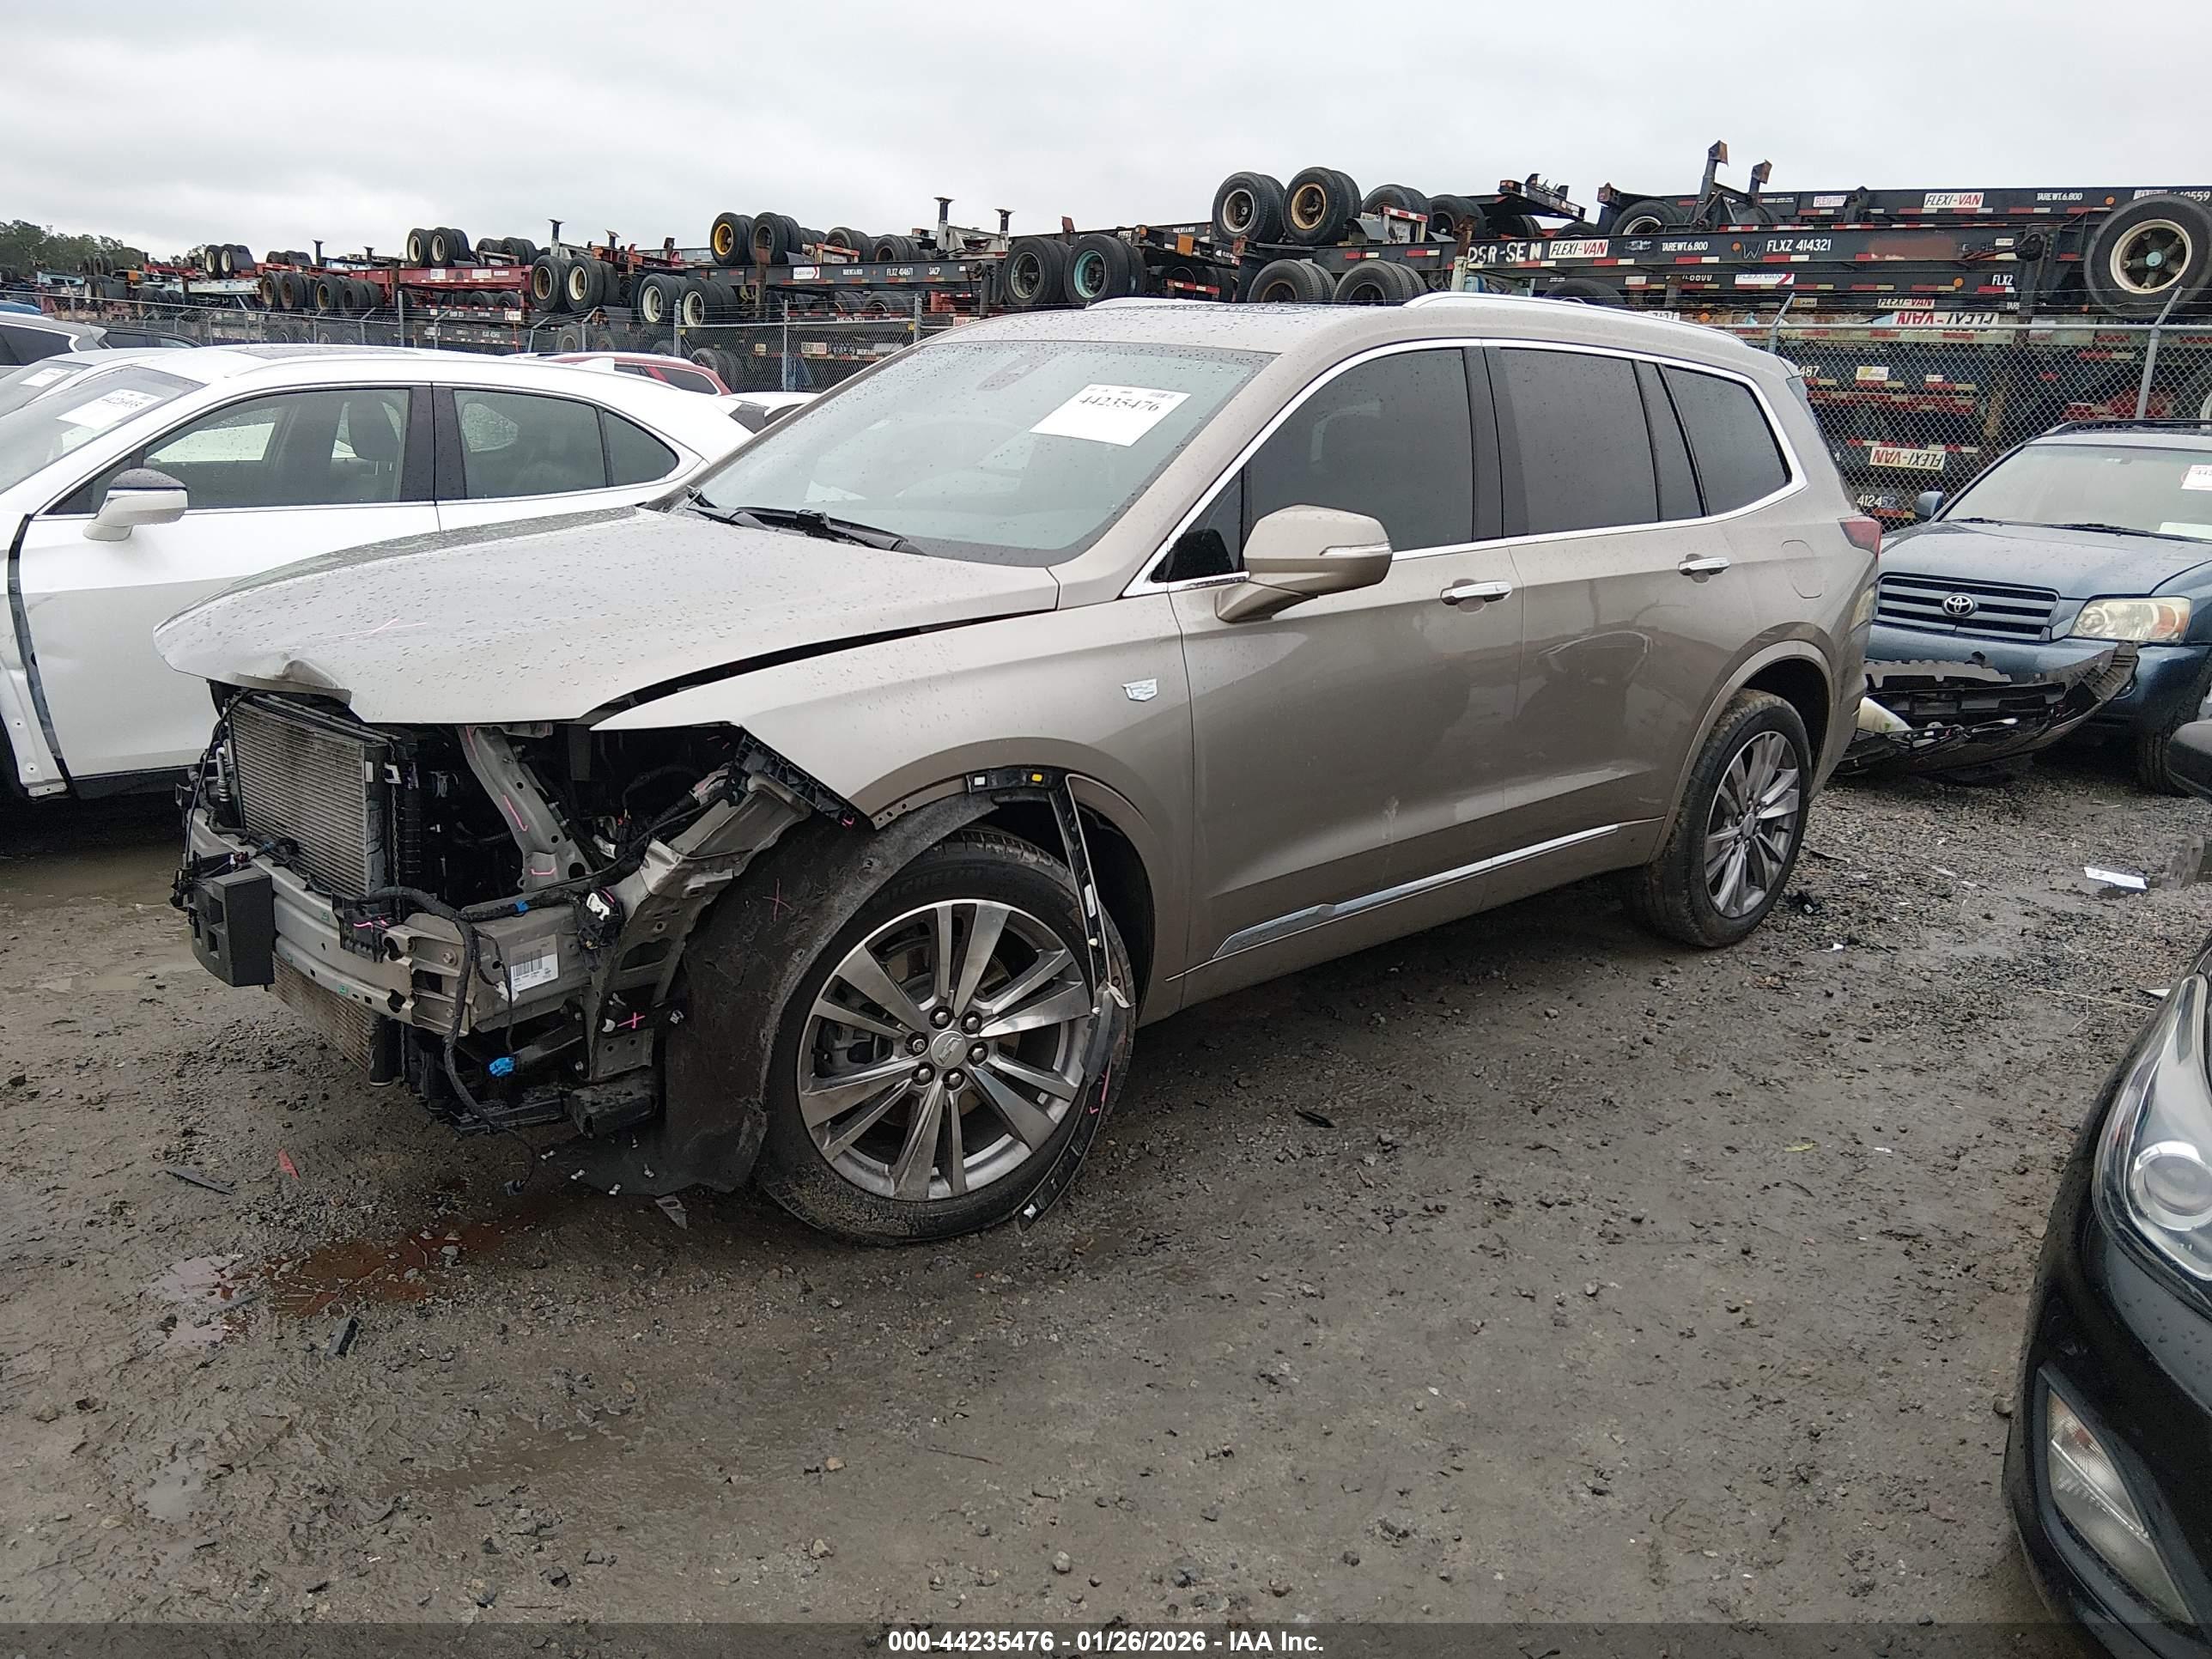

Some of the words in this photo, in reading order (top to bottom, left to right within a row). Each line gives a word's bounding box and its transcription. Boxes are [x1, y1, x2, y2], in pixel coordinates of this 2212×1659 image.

[1925, 193, 1982, 206] FLEXI-VAN
[1550, 240, 1607, 256] FLEXI-VAN
[1766, 240, 1794, 252] FLXZ
[1796, 239, 1832, 252] 414321
[1872, 450, 1945, 468] FLEXI-VAN
[1856, 494, 1897, 509] 412452
